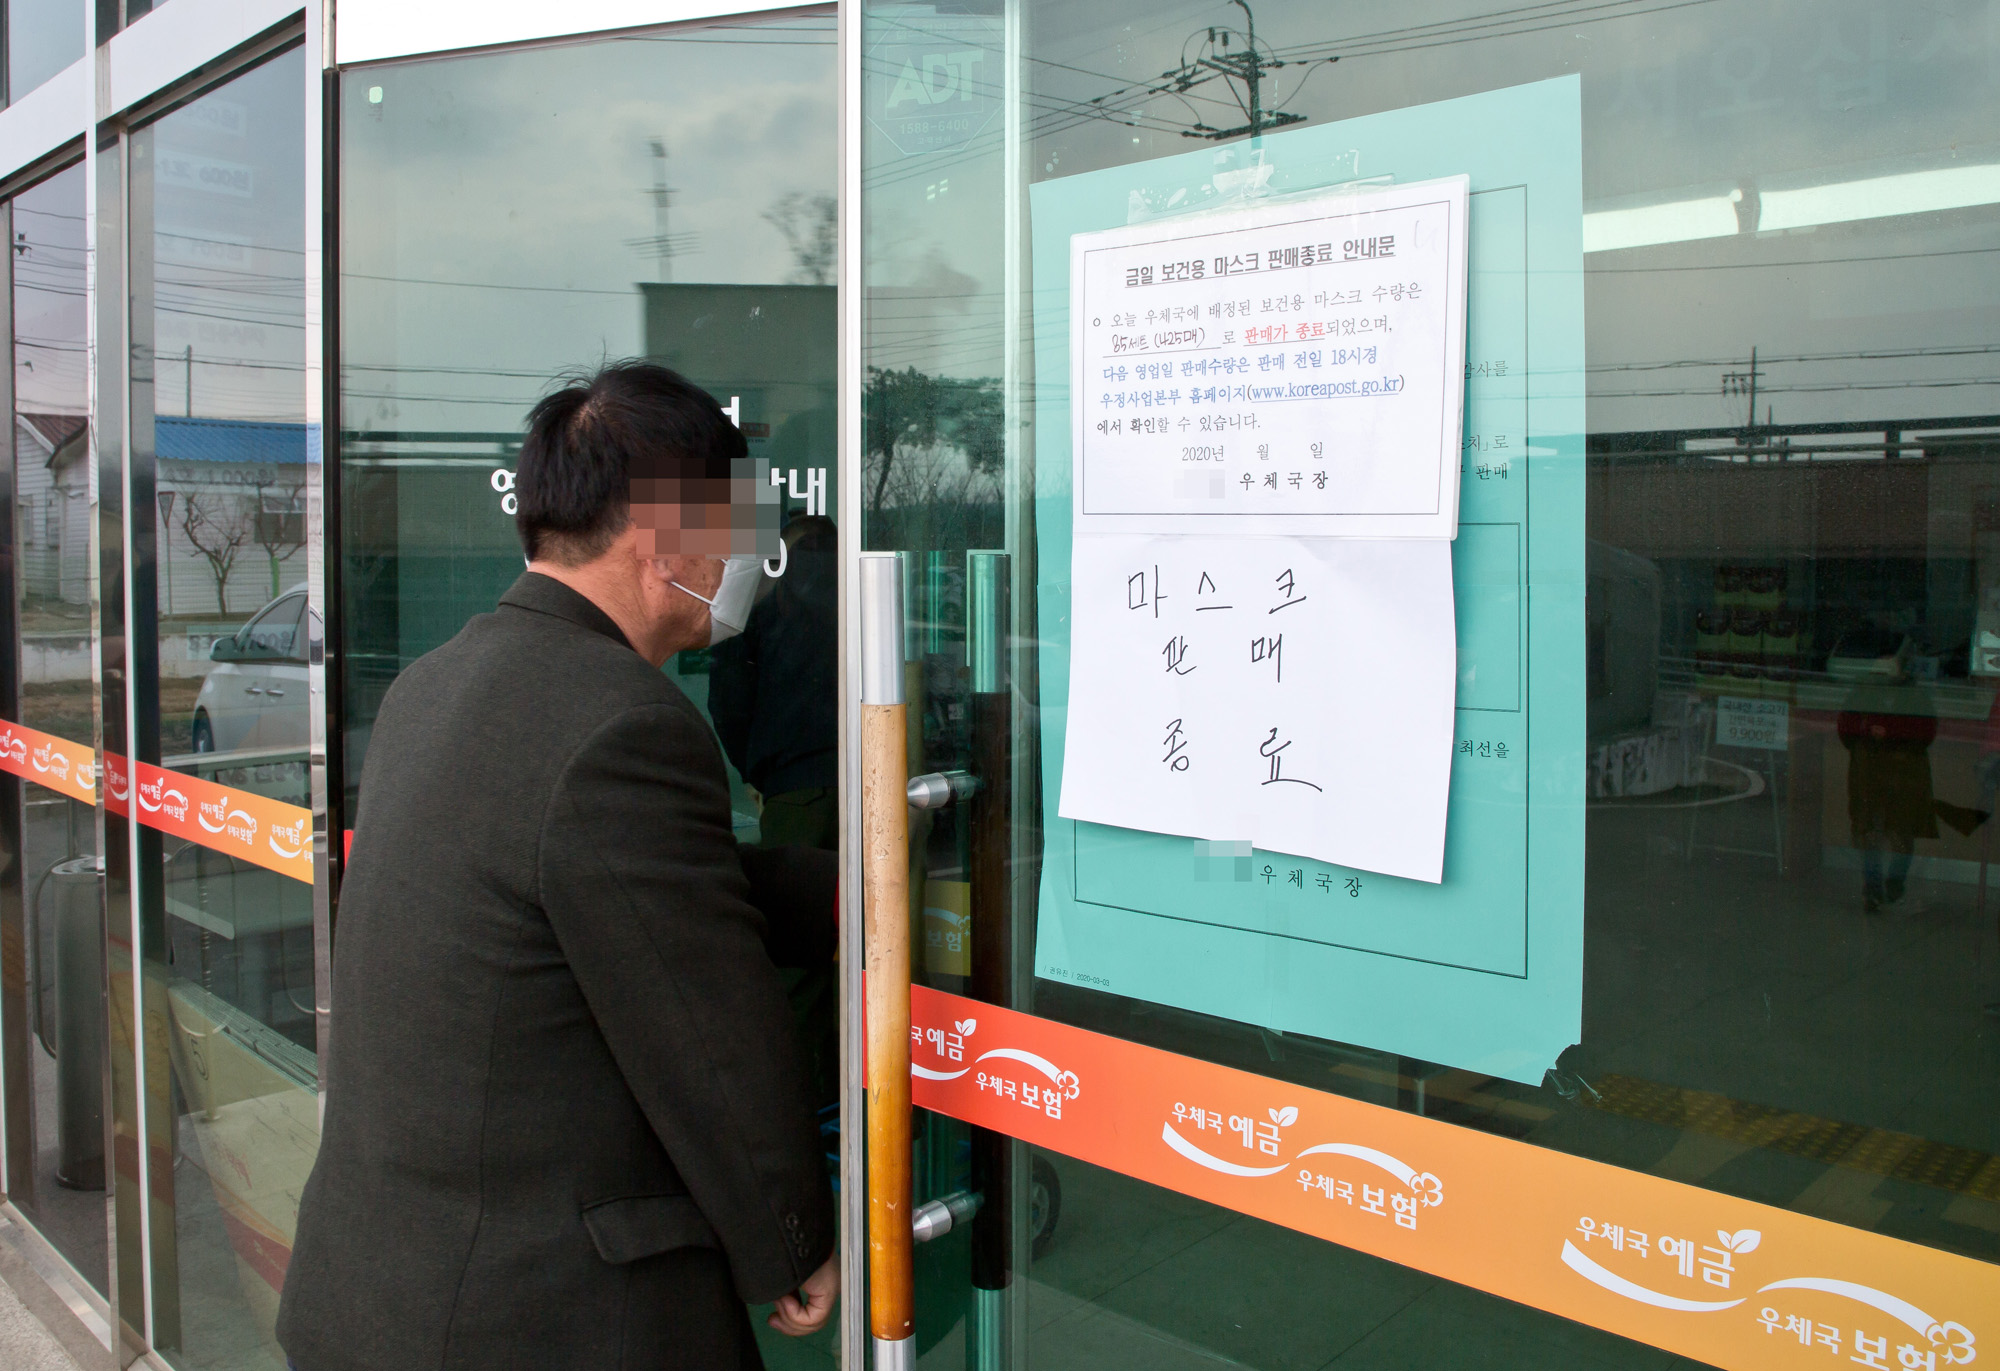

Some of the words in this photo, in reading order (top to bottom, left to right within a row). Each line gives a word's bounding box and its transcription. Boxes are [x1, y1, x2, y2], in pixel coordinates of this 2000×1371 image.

[887, 50, 984, 108] ADT
[900, 119, 969, 134] 1588-6400
[1126, 265, 1153, 286] 금일
[1162, 259, 1205, 282] 보건용
[1214, 252, 1260, 276] 마스크
[1268, 243, 1332, 269] 판매종료
[1343, 235, 1395, 260] 안내문
[1111, 313, 1137, 328] 오늘
[1145, 305, 1199, 324] 우체국에
[1208, 299, 1251, 319] 배정된
[1261, 293, 1305, 313] 보건용
[1314, 289, 1362, 308] 마스크
[1372, 282, 1422, 302] 수량은
[1111, 334, 1149, 353] 85세트
[1154, 327, 1205, 348] (425매)
[1222, 330, 1236, 345] 로
[1244, 323, 1288, 343] 판매가
[1103, 365, 1128, 382] 다음
[1135, 362, 1173, 380] 영업일
[1181, 356, 1250, 377] 판매수량은
[1257, 352, 1285, 371] 판매
[1293, 350, 1322, 369] 전일
[1331, 345, 1377, 366] 18시경
[1100, 388, 1181, 409] 우정사업본부
[1097, 418, 1121, 436] 에서
[1130, 417, 1170, 434] 확인할
[1177, 416, 1191, 433] 수
[1199, 413, 1261, 432] 있습니다.
[1182, 445, 1224, 462] 2020년
[1256, 443, 1269, 461] 월
[1310, 442, 1323, 459] 일
[1476, 462, 1508, 480] 판매
[1459, 739, 1510, 759] 최선을
[1076, 973, 1110, 987] 2020-03-03
[926, 1027, 965, 1062] 예금
[975, 1072, 1017, 1101] 우체국
[1020, 1082, 1062, 1120] 보험
[1171, 1102, 1224, 1135] 우체국
[1228, 1114, 1282, 1156] 예금
[1296, 1169, 1355, 1206] 우체국
[1360, 1183, 1418, 1231] 보험
[1575, 1216, 1651, 1258] 우체국
[1658, 1235, 1736, 1289] 예금
[1756, 1306, 1842, 1354] 우체국
